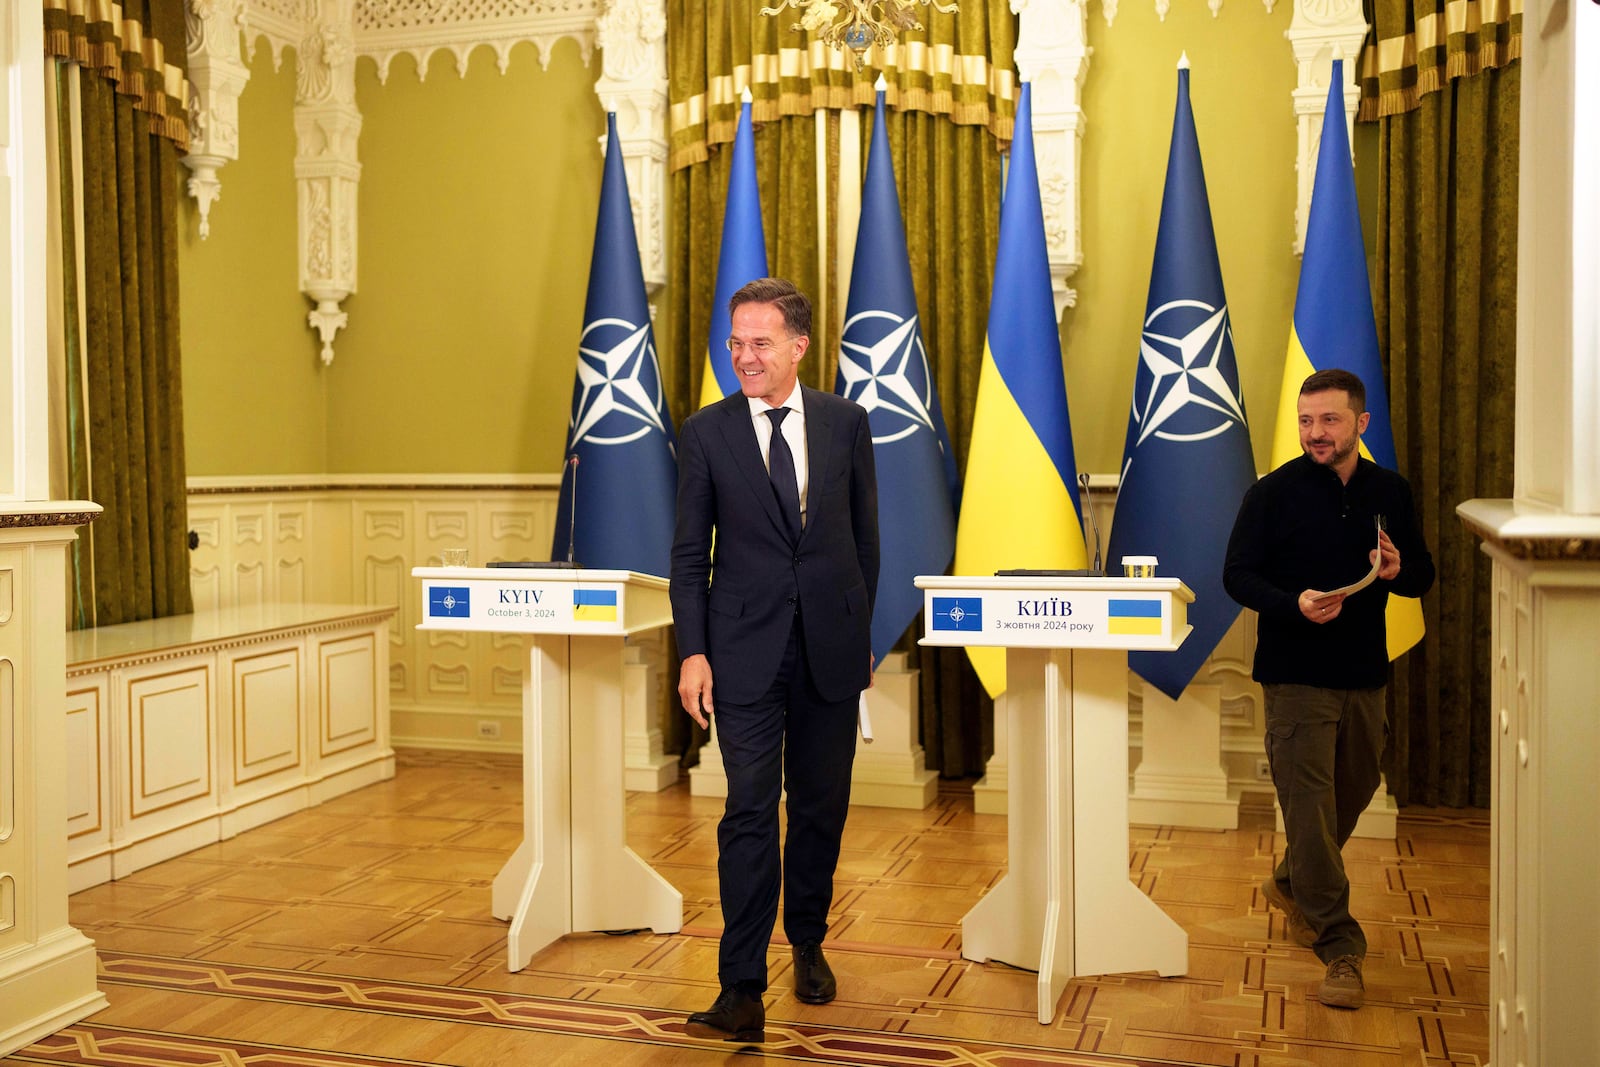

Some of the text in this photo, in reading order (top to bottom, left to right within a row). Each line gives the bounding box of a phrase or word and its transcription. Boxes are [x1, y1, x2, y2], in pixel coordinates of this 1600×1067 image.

[499, 589, 544, 604] KYIV
[487, 608, 555, 618] October 3, 2024
[1016, 597, 1073, 617] КИЇВ
[995, 620, 1094, 633] 3 жовтня 2024 року
